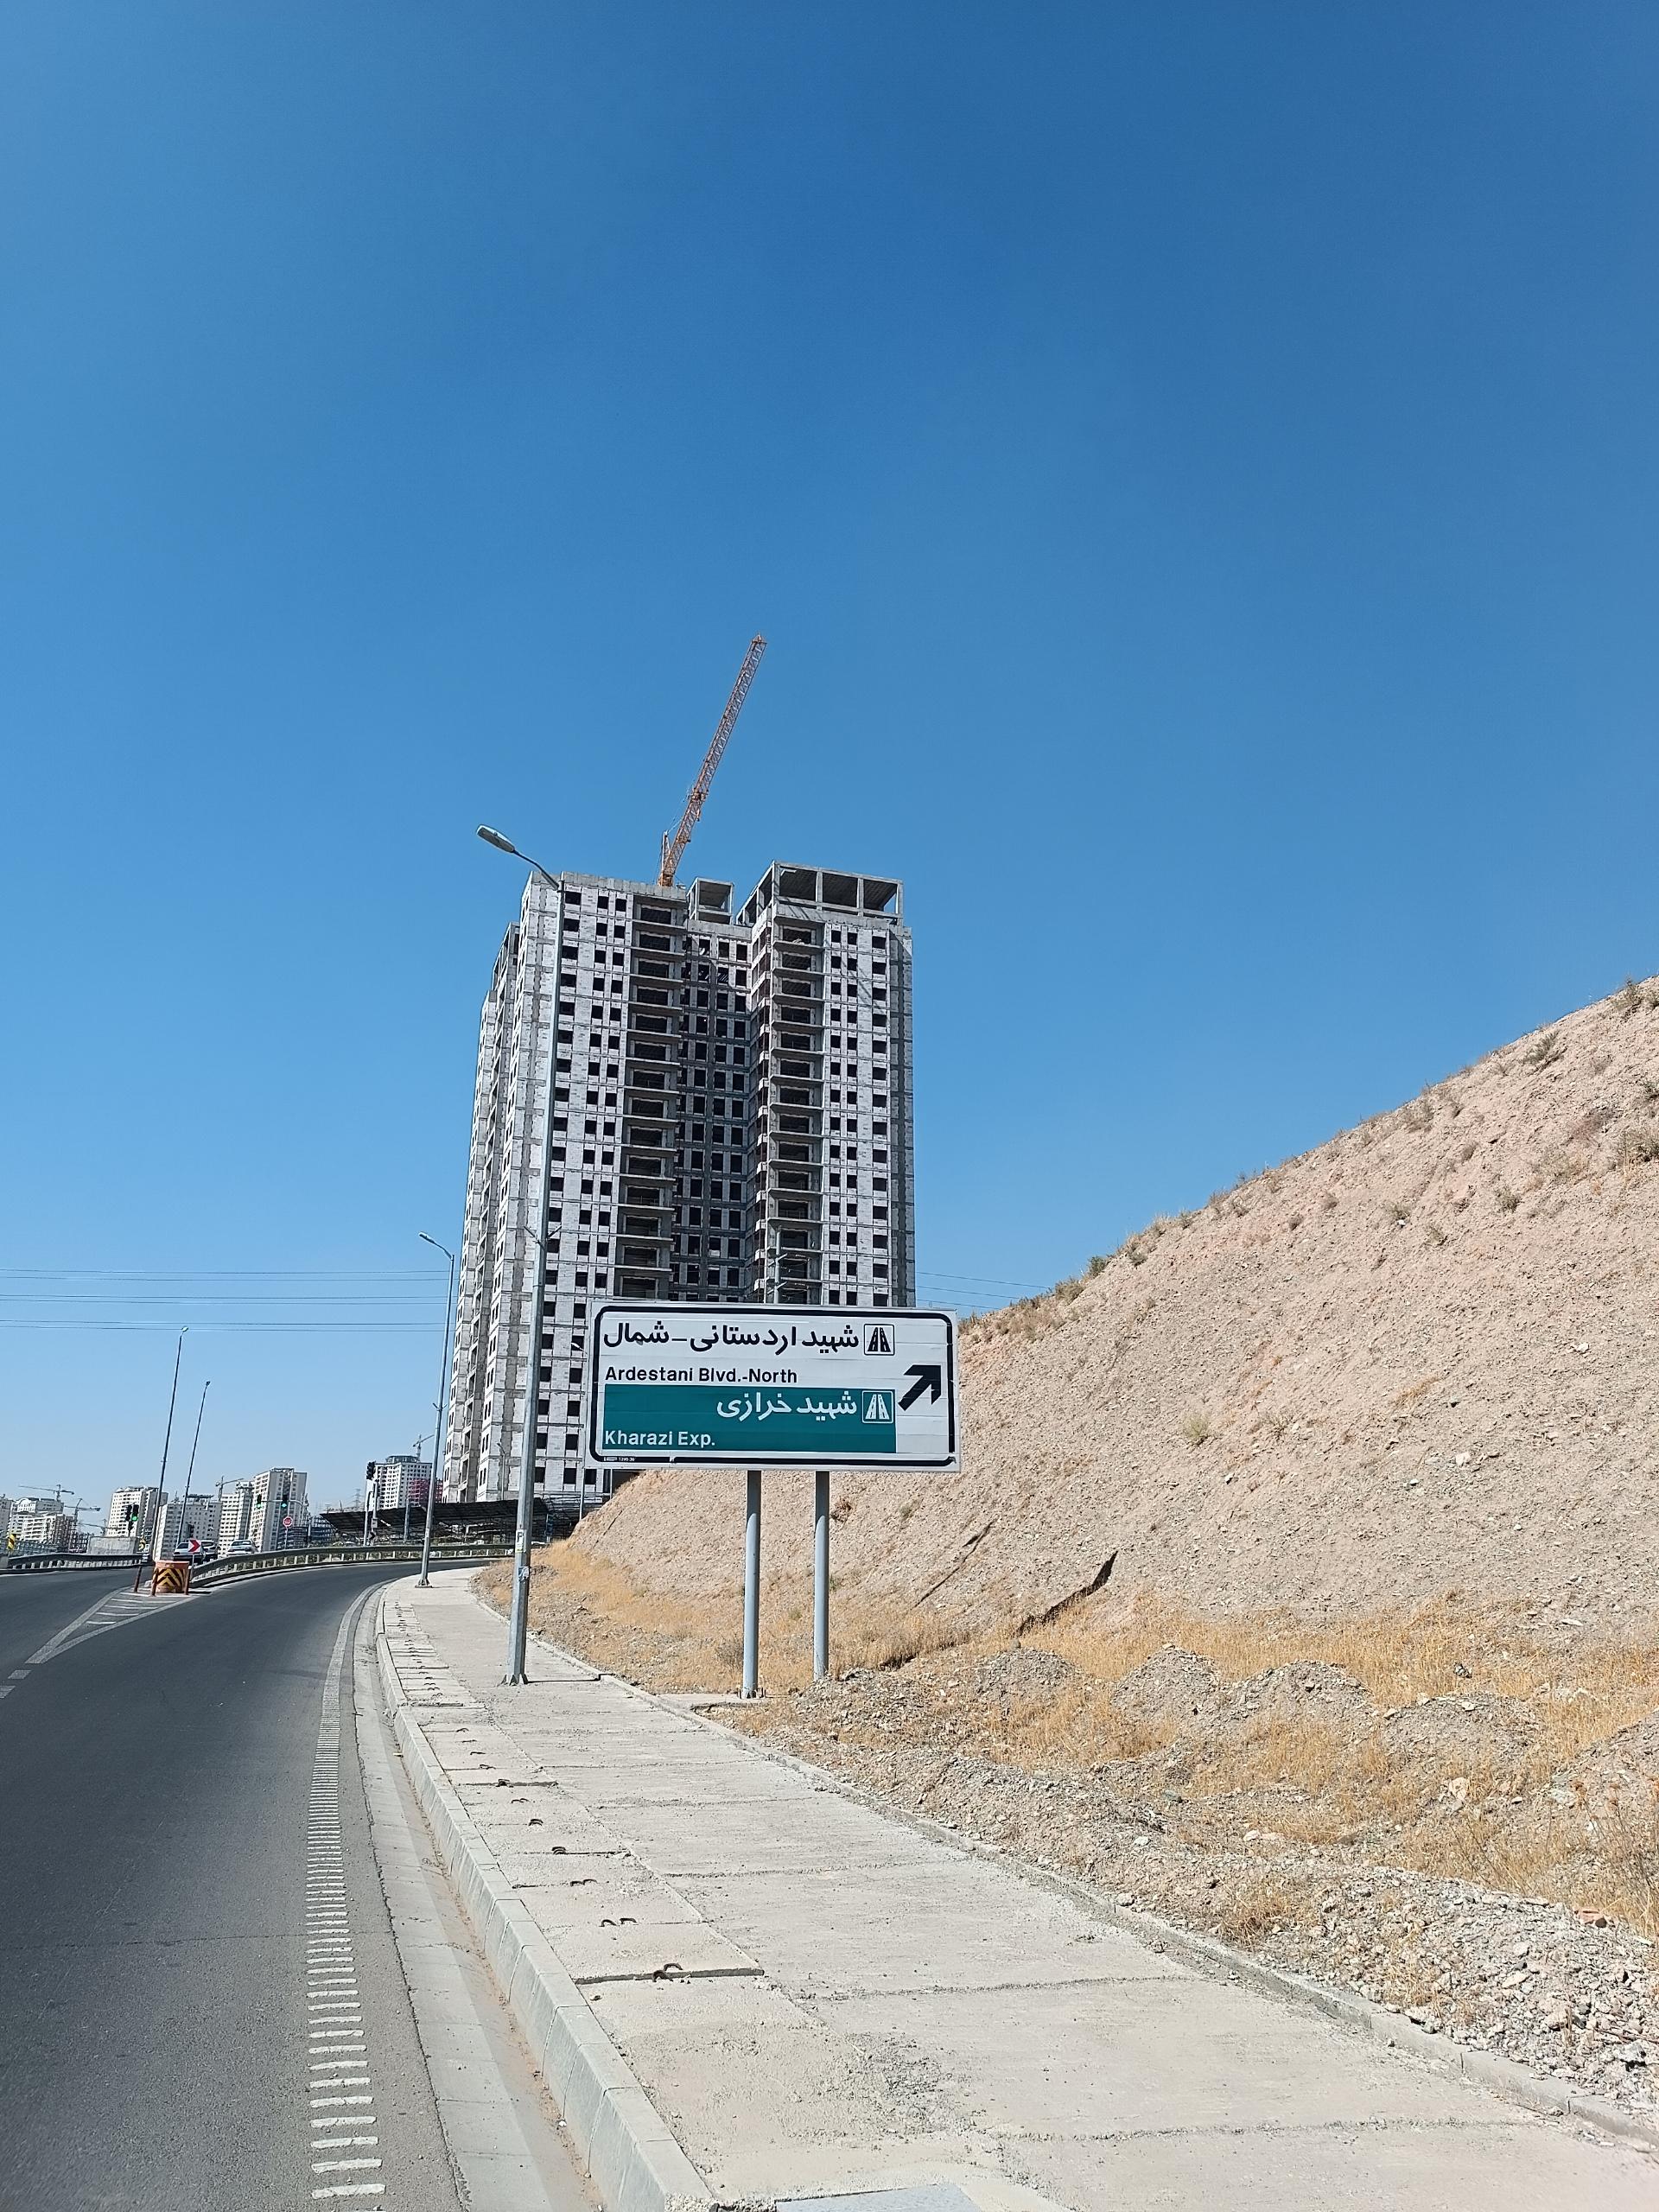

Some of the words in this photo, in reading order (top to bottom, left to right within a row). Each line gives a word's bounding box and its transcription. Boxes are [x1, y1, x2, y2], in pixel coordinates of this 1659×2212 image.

[802, 1325, 859, 1354] شهید
[605, 1366, 693, 1382] Ardestani
[716, 1391, 792, 1421] خرازی
[796, 1390, 858, 1421] شهید
[605, 1430, 672, 1446] Kharazi
[677, 1431, 715, 1447] Exp.
